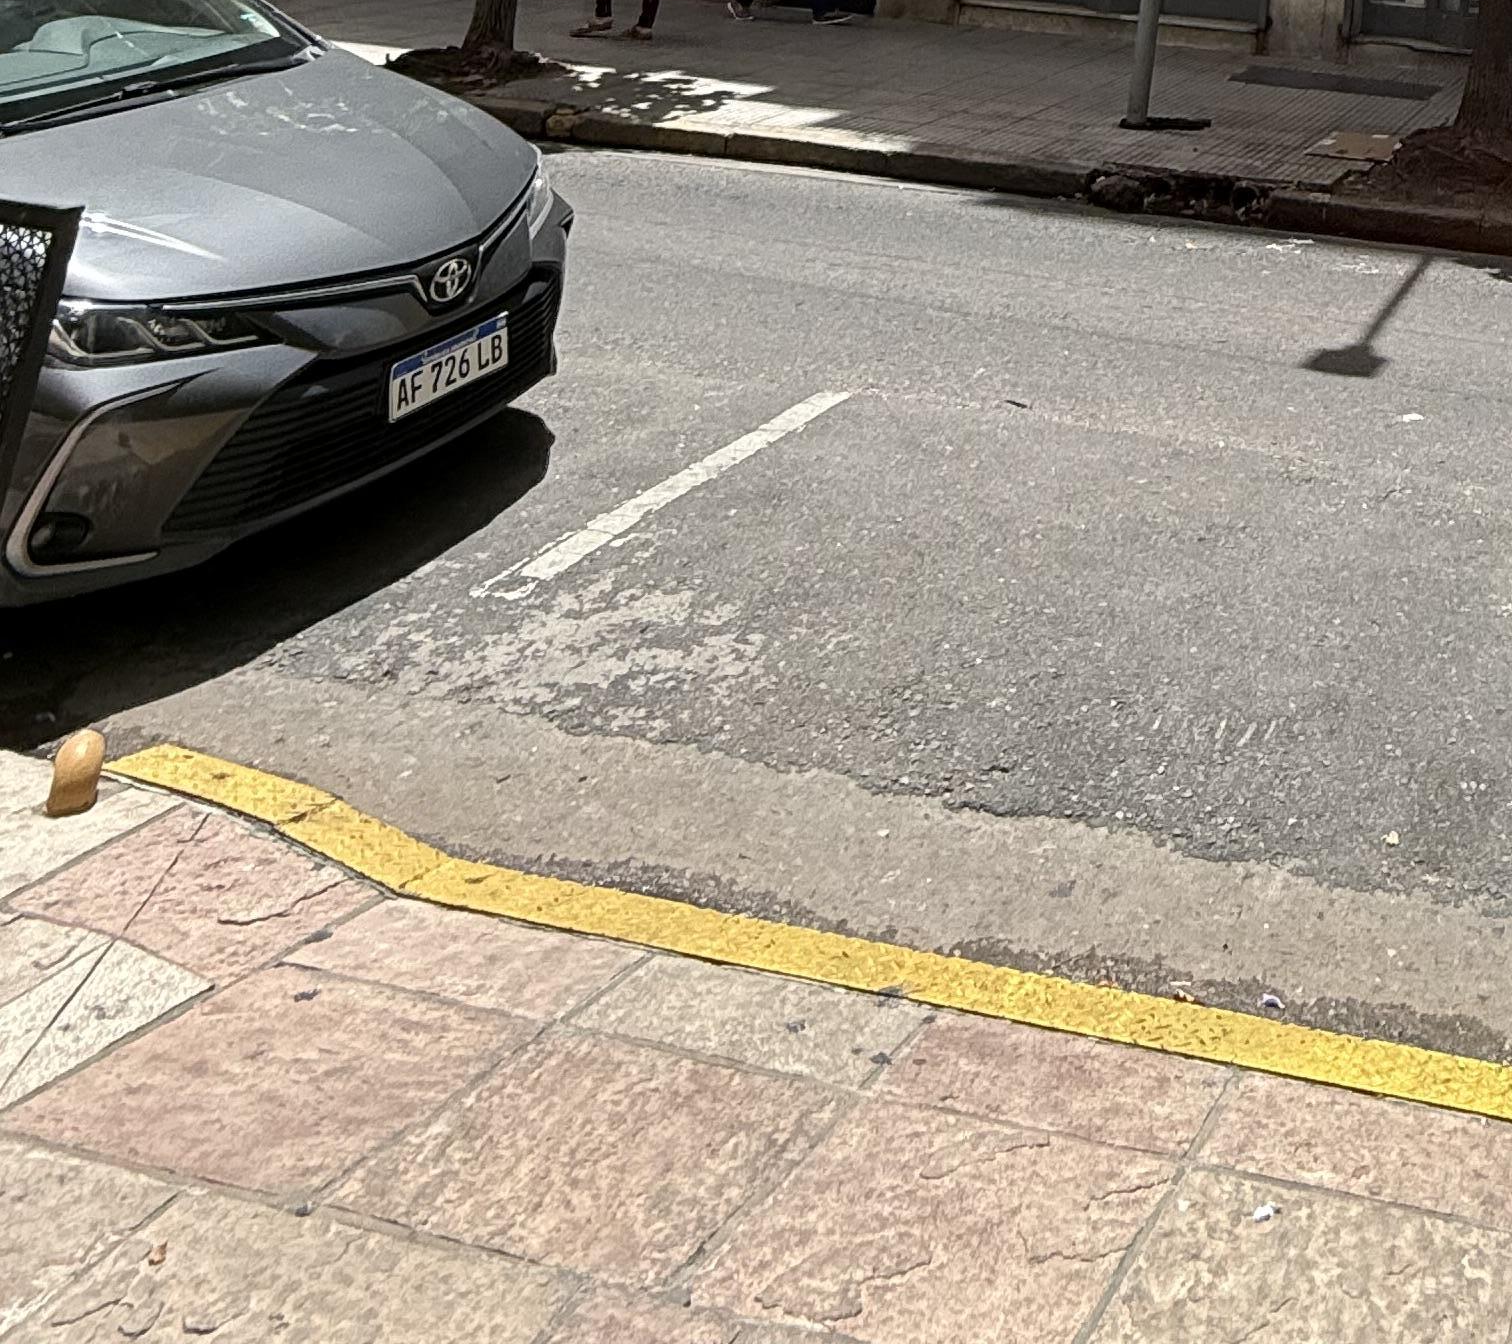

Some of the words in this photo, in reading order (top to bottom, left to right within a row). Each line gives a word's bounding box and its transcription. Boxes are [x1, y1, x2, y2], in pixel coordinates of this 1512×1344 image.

[397, 371, 424, 411] AF
[431, 348, 470, 393] 726
[477, 334, 503, 370] LB
